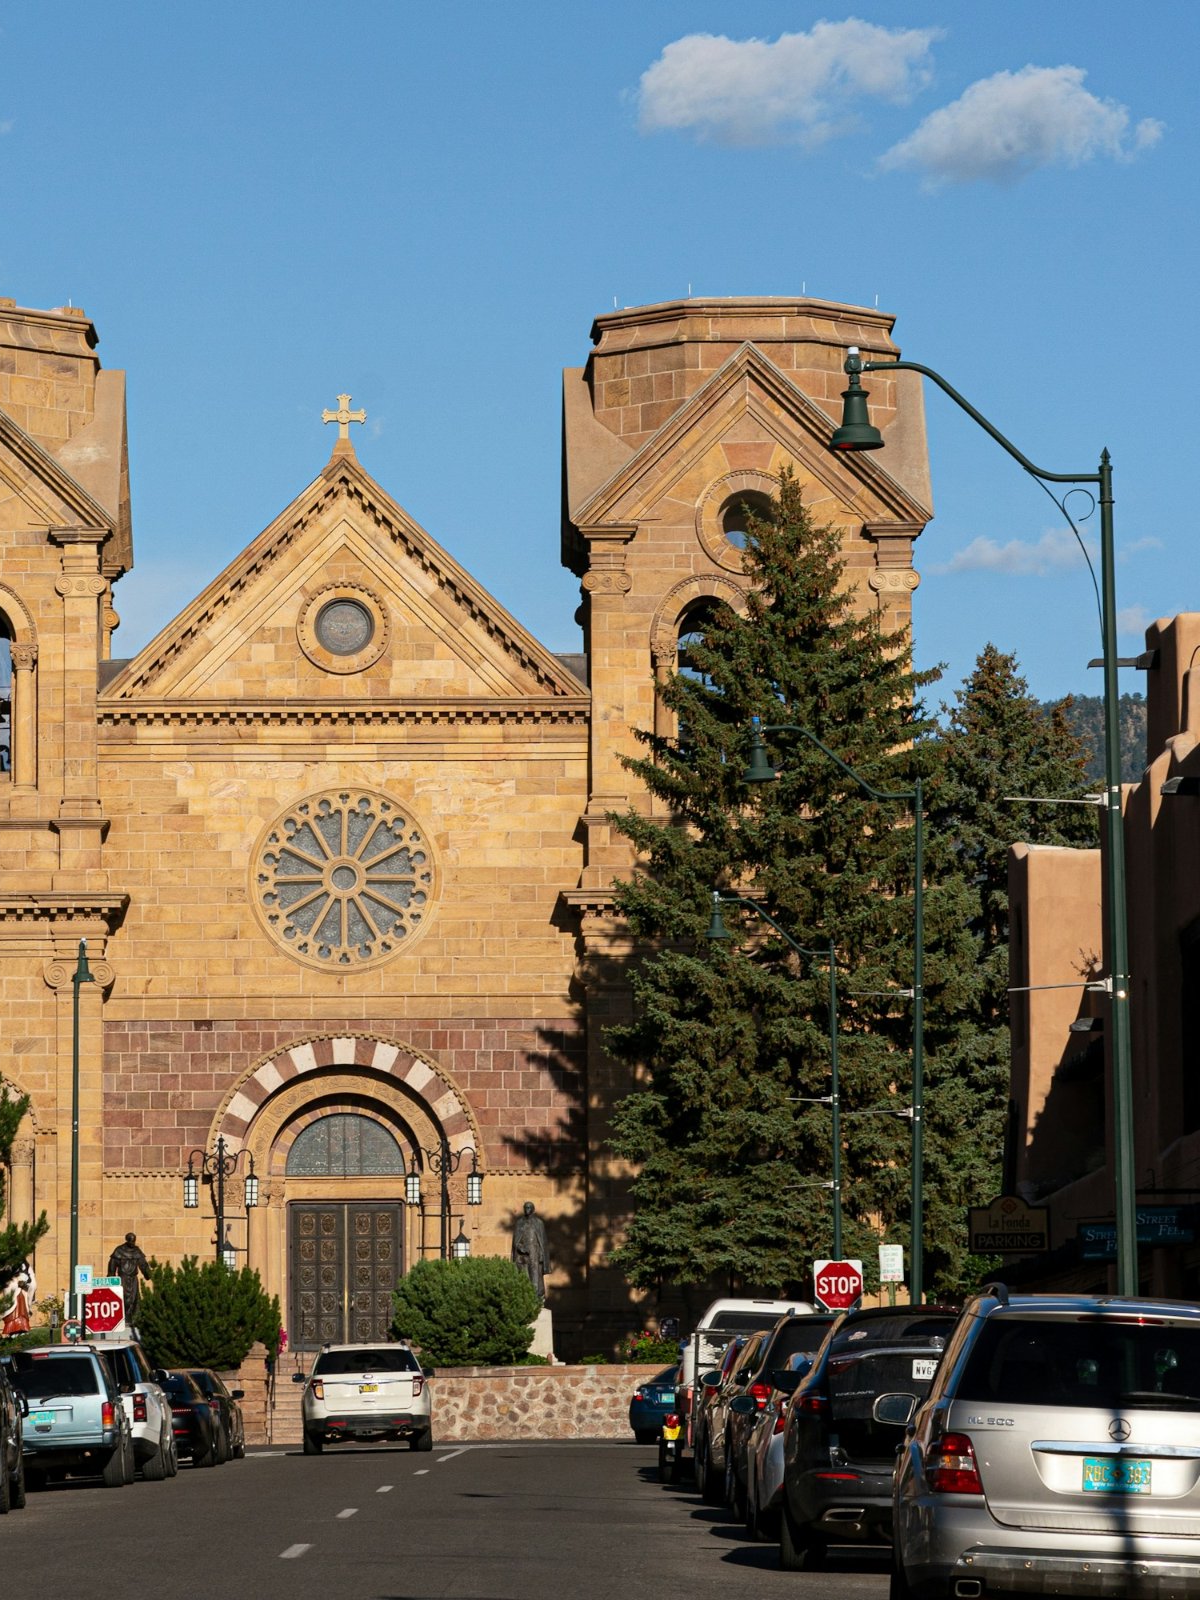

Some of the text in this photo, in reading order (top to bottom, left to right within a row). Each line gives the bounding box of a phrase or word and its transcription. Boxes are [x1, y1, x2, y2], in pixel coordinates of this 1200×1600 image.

[977, 1234, 1041, 1248] PARKING
[818, 1276, 860, 1295] STOP
[85, 1301, 120, 1319] STOP
